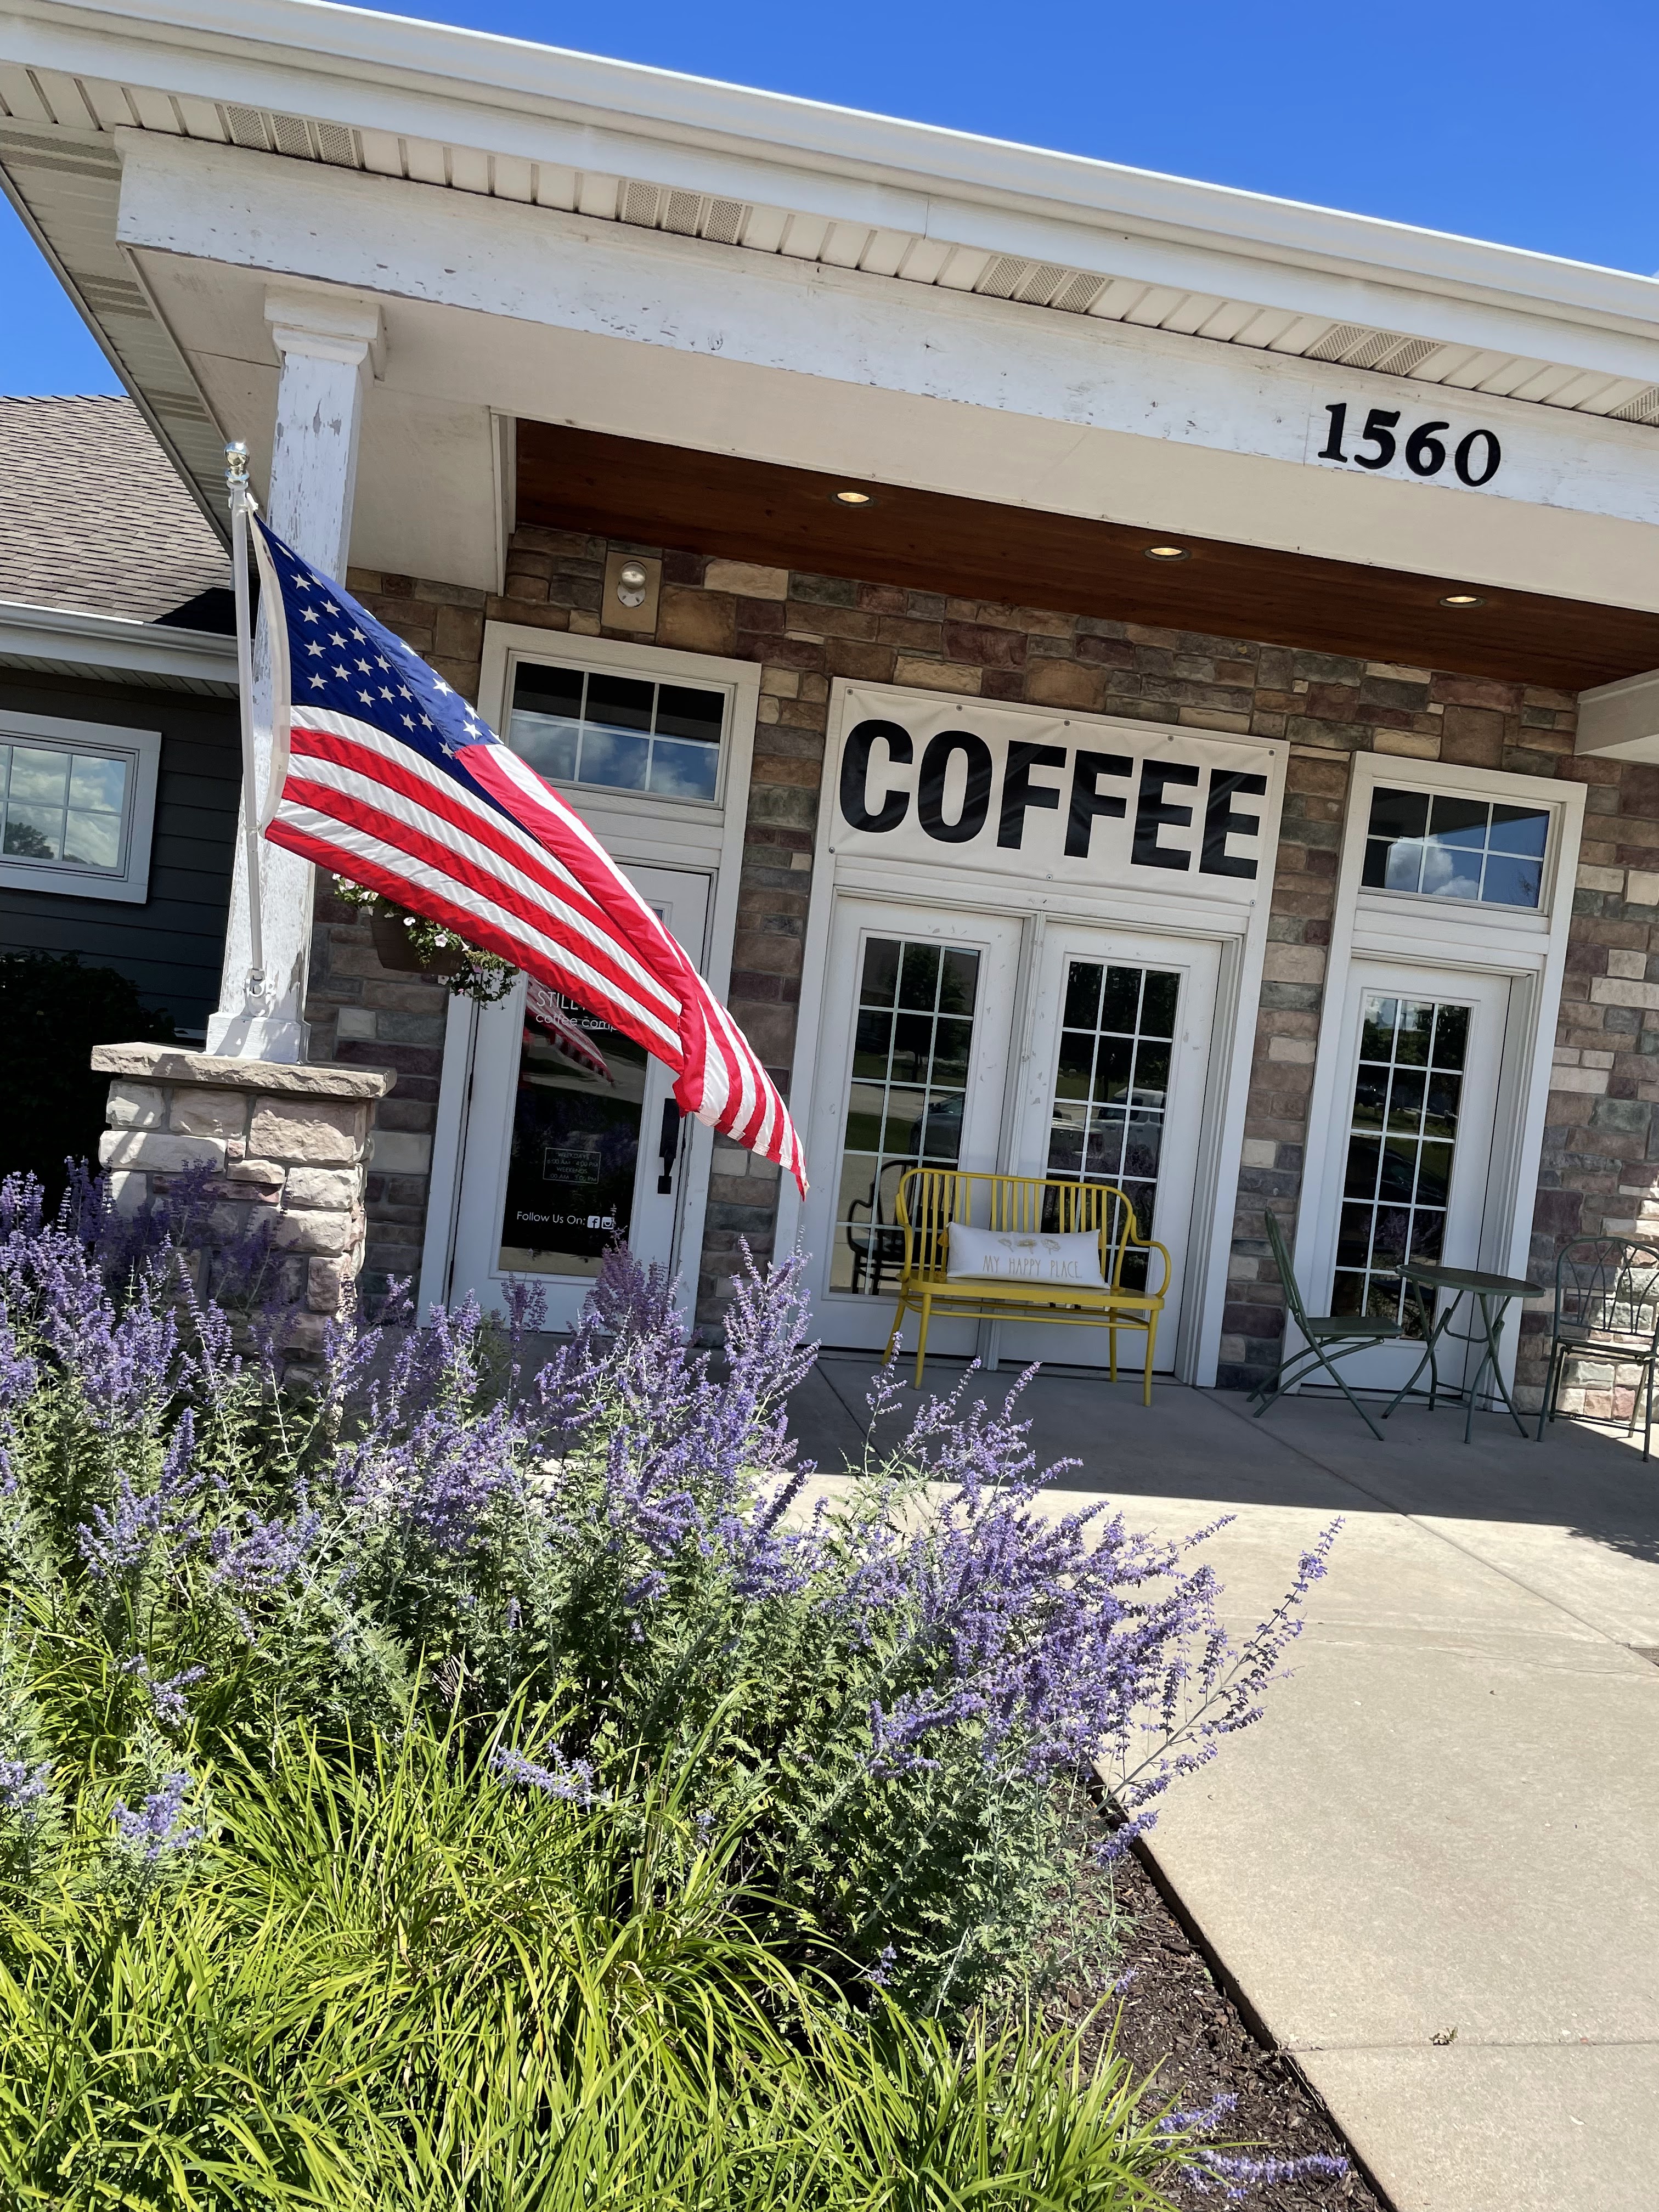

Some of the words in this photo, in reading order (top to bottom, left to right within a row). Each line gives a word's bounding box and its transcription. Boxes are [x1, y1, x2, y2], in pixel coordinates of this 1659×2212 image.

[1318, 403, 1501, 487] 1560
[839, 719, 1267, 879] COFFEE
[537, 990, 578, 1010] STILL
[536, 1013, 578, 1027] coffee
[517, 1211, 550, 1222] Follow
[552, 1214, 564, 1223] Us
[567, 1215, 586, 1225] On:
[983, 1255, 1000, 1273] MY
[1009, 1257, 1041, 1277] HAPPY
[1050, 1260, 1082, 1278] PLACE
